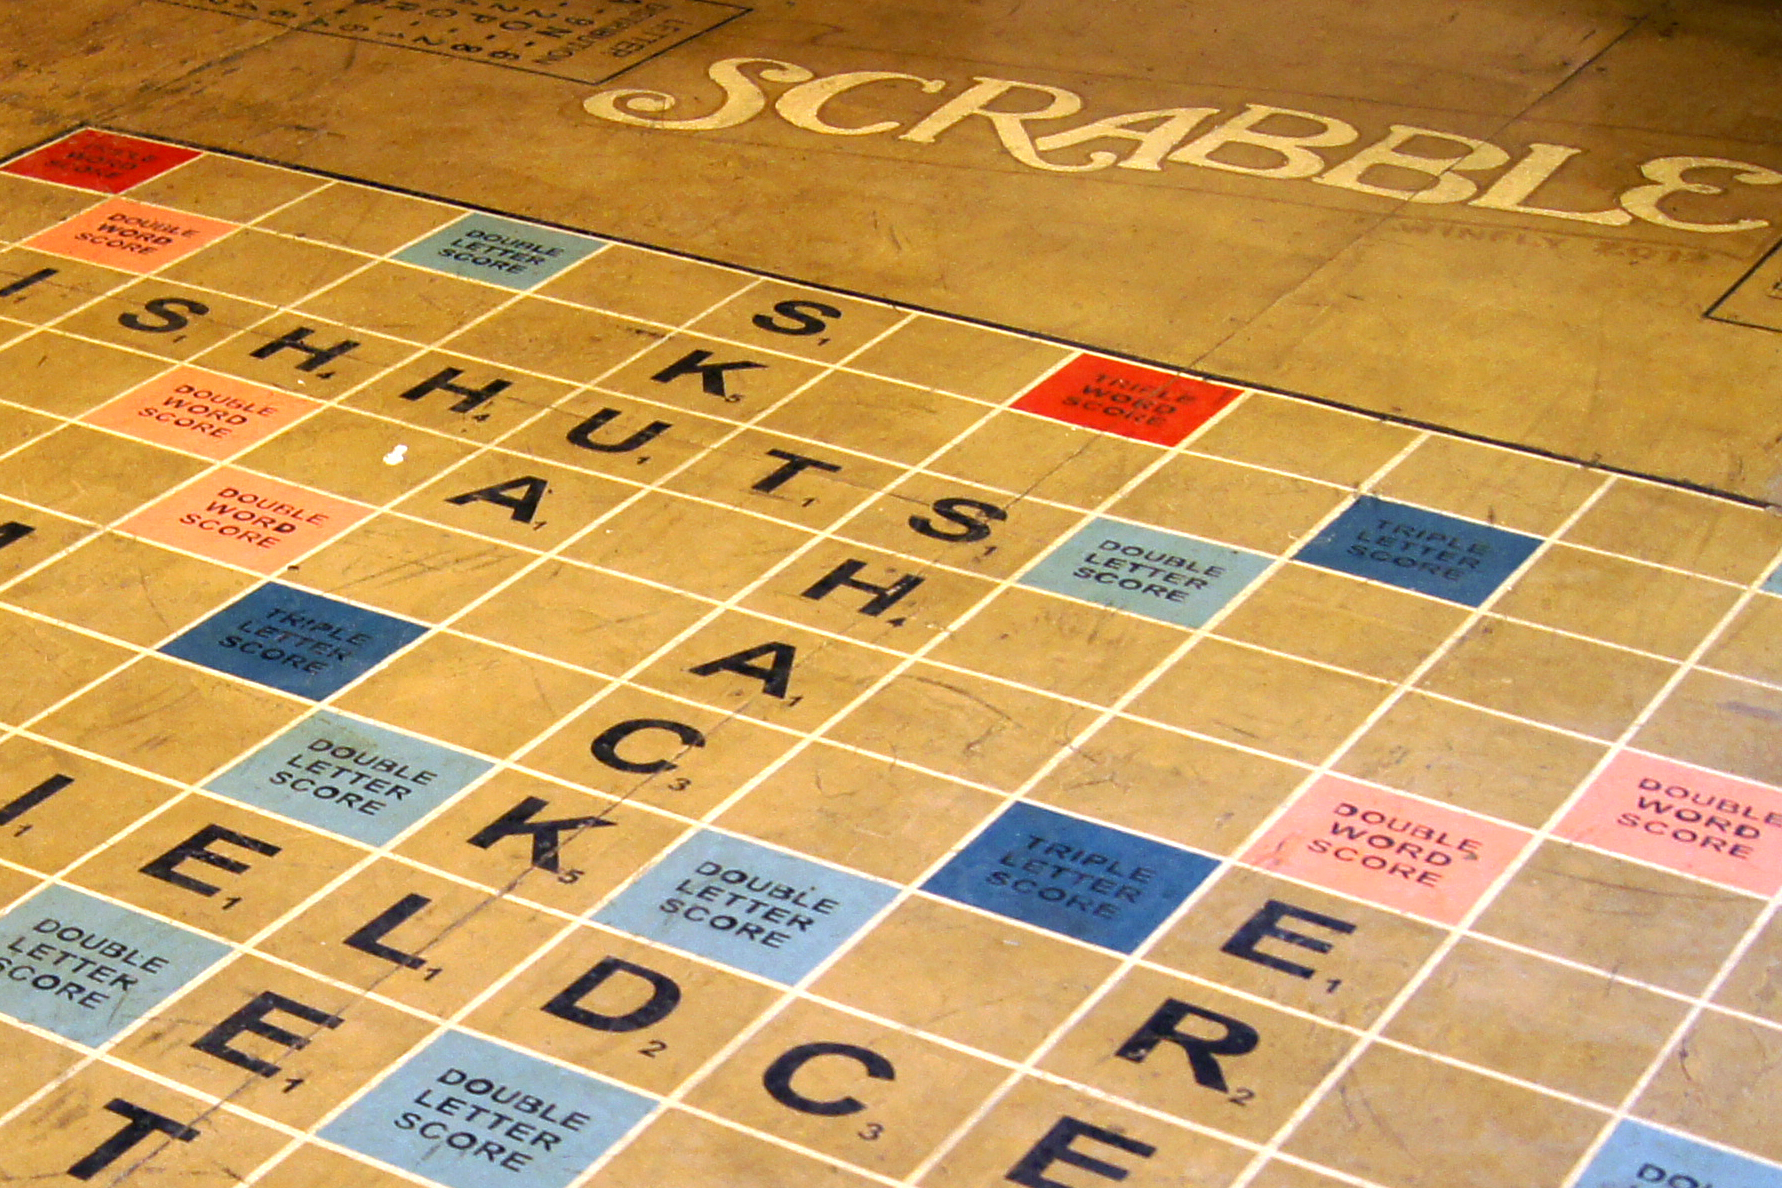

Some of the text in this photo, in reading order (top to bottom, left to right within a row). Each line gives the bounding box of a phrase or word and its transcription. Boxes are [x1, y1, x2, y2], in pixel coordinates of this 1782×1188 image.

[583, 57, 1781, 233] SCRABBLE
[74, 232, 157, 255] SCORE
[96, 222, 174, 246] WORD
[106, 212, 200, 238] DOUBLE
[464, 229, 566, 258] DOUBLE
[437, 247, 527, 275] SCORE
[449, 237, 547, 266] LETTER
[161, 396, 250, 426] WORD
[173, 383, 271, 416] DOUBLE
[142, 407, 229, 438] SCORE
[205, 501, 298, 534] WORD
[216, 487, 325, 524] DOUBLE
[179, 513, 273, 548] SCORE
[1083, 552, 1210, 591] LETTER
[1097, 539, 1225, 578] DOUBLE
[1071, 566, 1190, 603] SCORE
[236, 619, 353, 662] LETTER
[264, 607, 373, 649] TRIPLE
[217, 634, 328, 674] SCORE
[285, 753, 413, 801] LETTER
[306, 737, 439, 786] DOUBLE
[268, 770, 388, 816] SCORE
[1333, 802, 1478, 856] DOUBLE
[1620, 813, 1751, 858] SCORE
[1636, 796, 1762, 840] WORD
[1025, 833, 1157, 885] TRIPLE
[1307, 839, 1440, 886] SCORE
[1329, 821, 1454, 867] WORD
[694, 860, 840, 915] DOUBLE
[984, 870, 1116, 921] SCORE
[997, 851, 1144, 904] LETTER
[658, 897, 792, 949] SCORE
[674, 878, 816, 933] LETTER
[6, 935, 140, 993] LETTER
[31, 917, 170, 975] DOUBLE
[413, 1088, 563, 1152] LETTER
[436, 1067, 591, 1132] DOUBLE
[393, 1111, 534, 1173] SCORE
